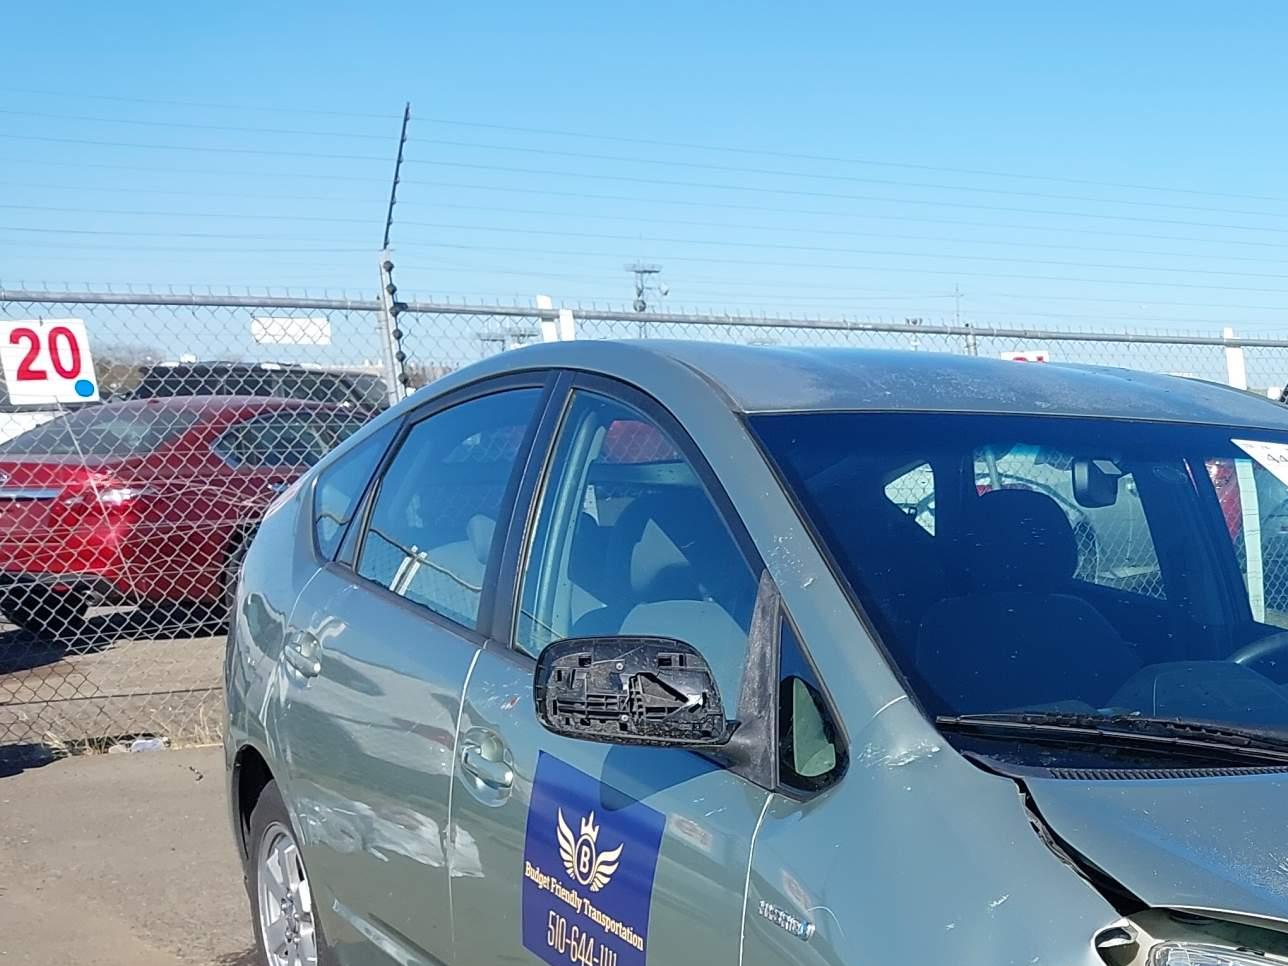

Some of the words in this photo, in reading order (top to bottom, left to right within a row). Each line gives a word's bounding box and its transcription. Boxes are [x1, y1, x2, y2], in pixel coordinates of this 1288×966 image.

[9, 326, 82, 381] 20
[579, 844, 591, 874] B
[524, 860, 551, 889] Budget
[550, 877, 583, 914] Friendly
[583, 898, 645, 952] Transportation
